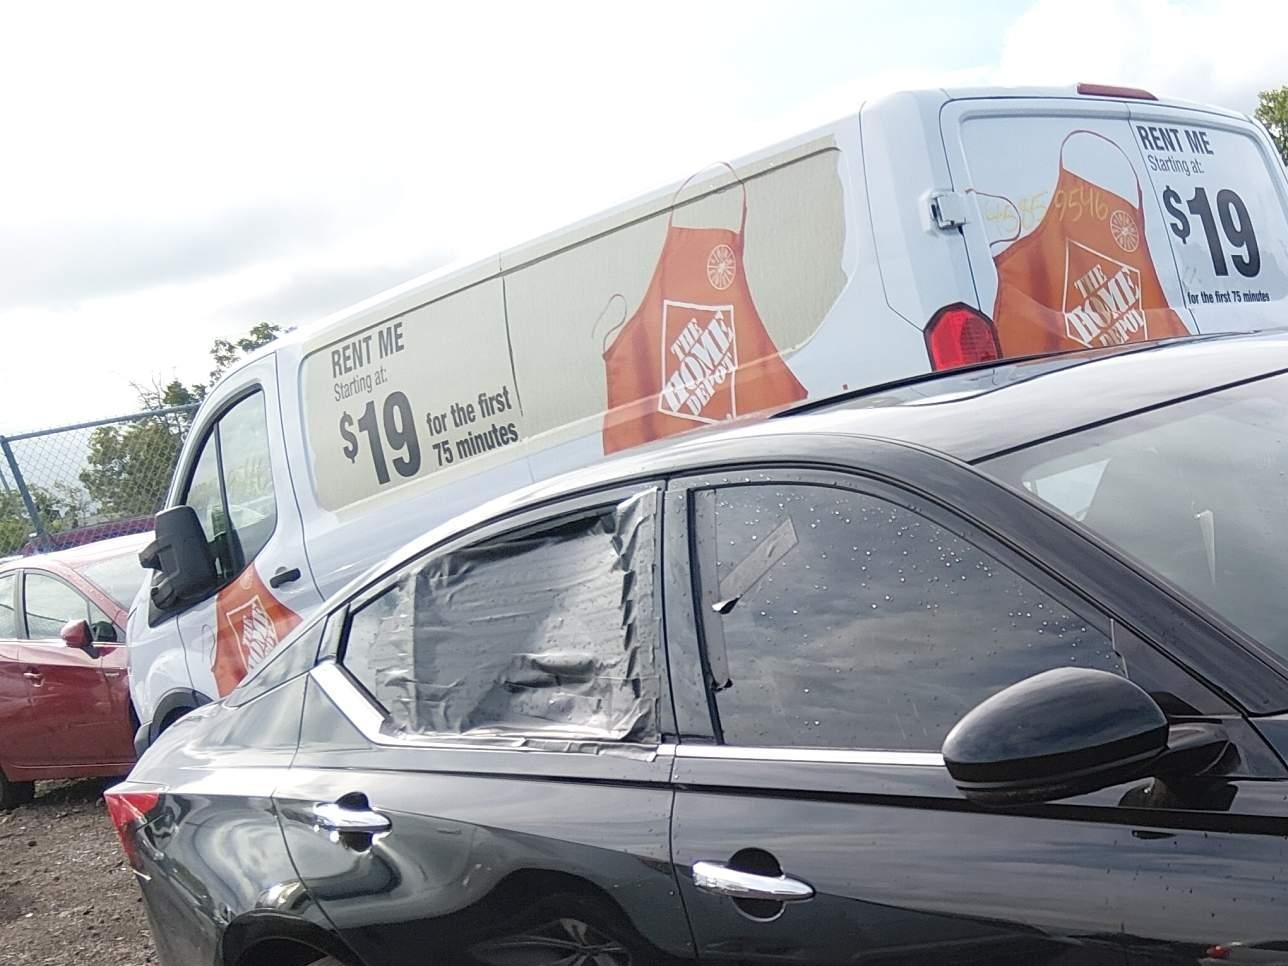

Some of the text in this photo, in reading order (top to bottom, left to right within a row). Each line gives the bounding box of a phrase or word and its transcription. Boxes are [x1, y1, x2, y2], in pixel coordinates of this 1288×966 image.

[1136, 125, 1214, 155] RENT ME
[1148, 155, 1204, 176] Starting at:
[1054, 184, 1108, 222] 9546
[1162, 185, 1261, 278] $19
[1074, 264, 1107, 298] THE
[1187, 290, 1270, 304] for the first 75 minutes
[1066, 266, 1141, 344] HOME
[671, 318, 702, 361] THE
[1100, 310, 1144, 346] DEPOT
[331, 322, 404, 378] RENT ME
[663, 310, 735, 413] HOME
[334, 367, 388, 402] Starting at:
[687, 352, 736, 416] DEPOT
[426, 386, 512, 436] for the first
[340, 391, 421, 485] $19
[432, 423, 519, 466] 75 minutes
